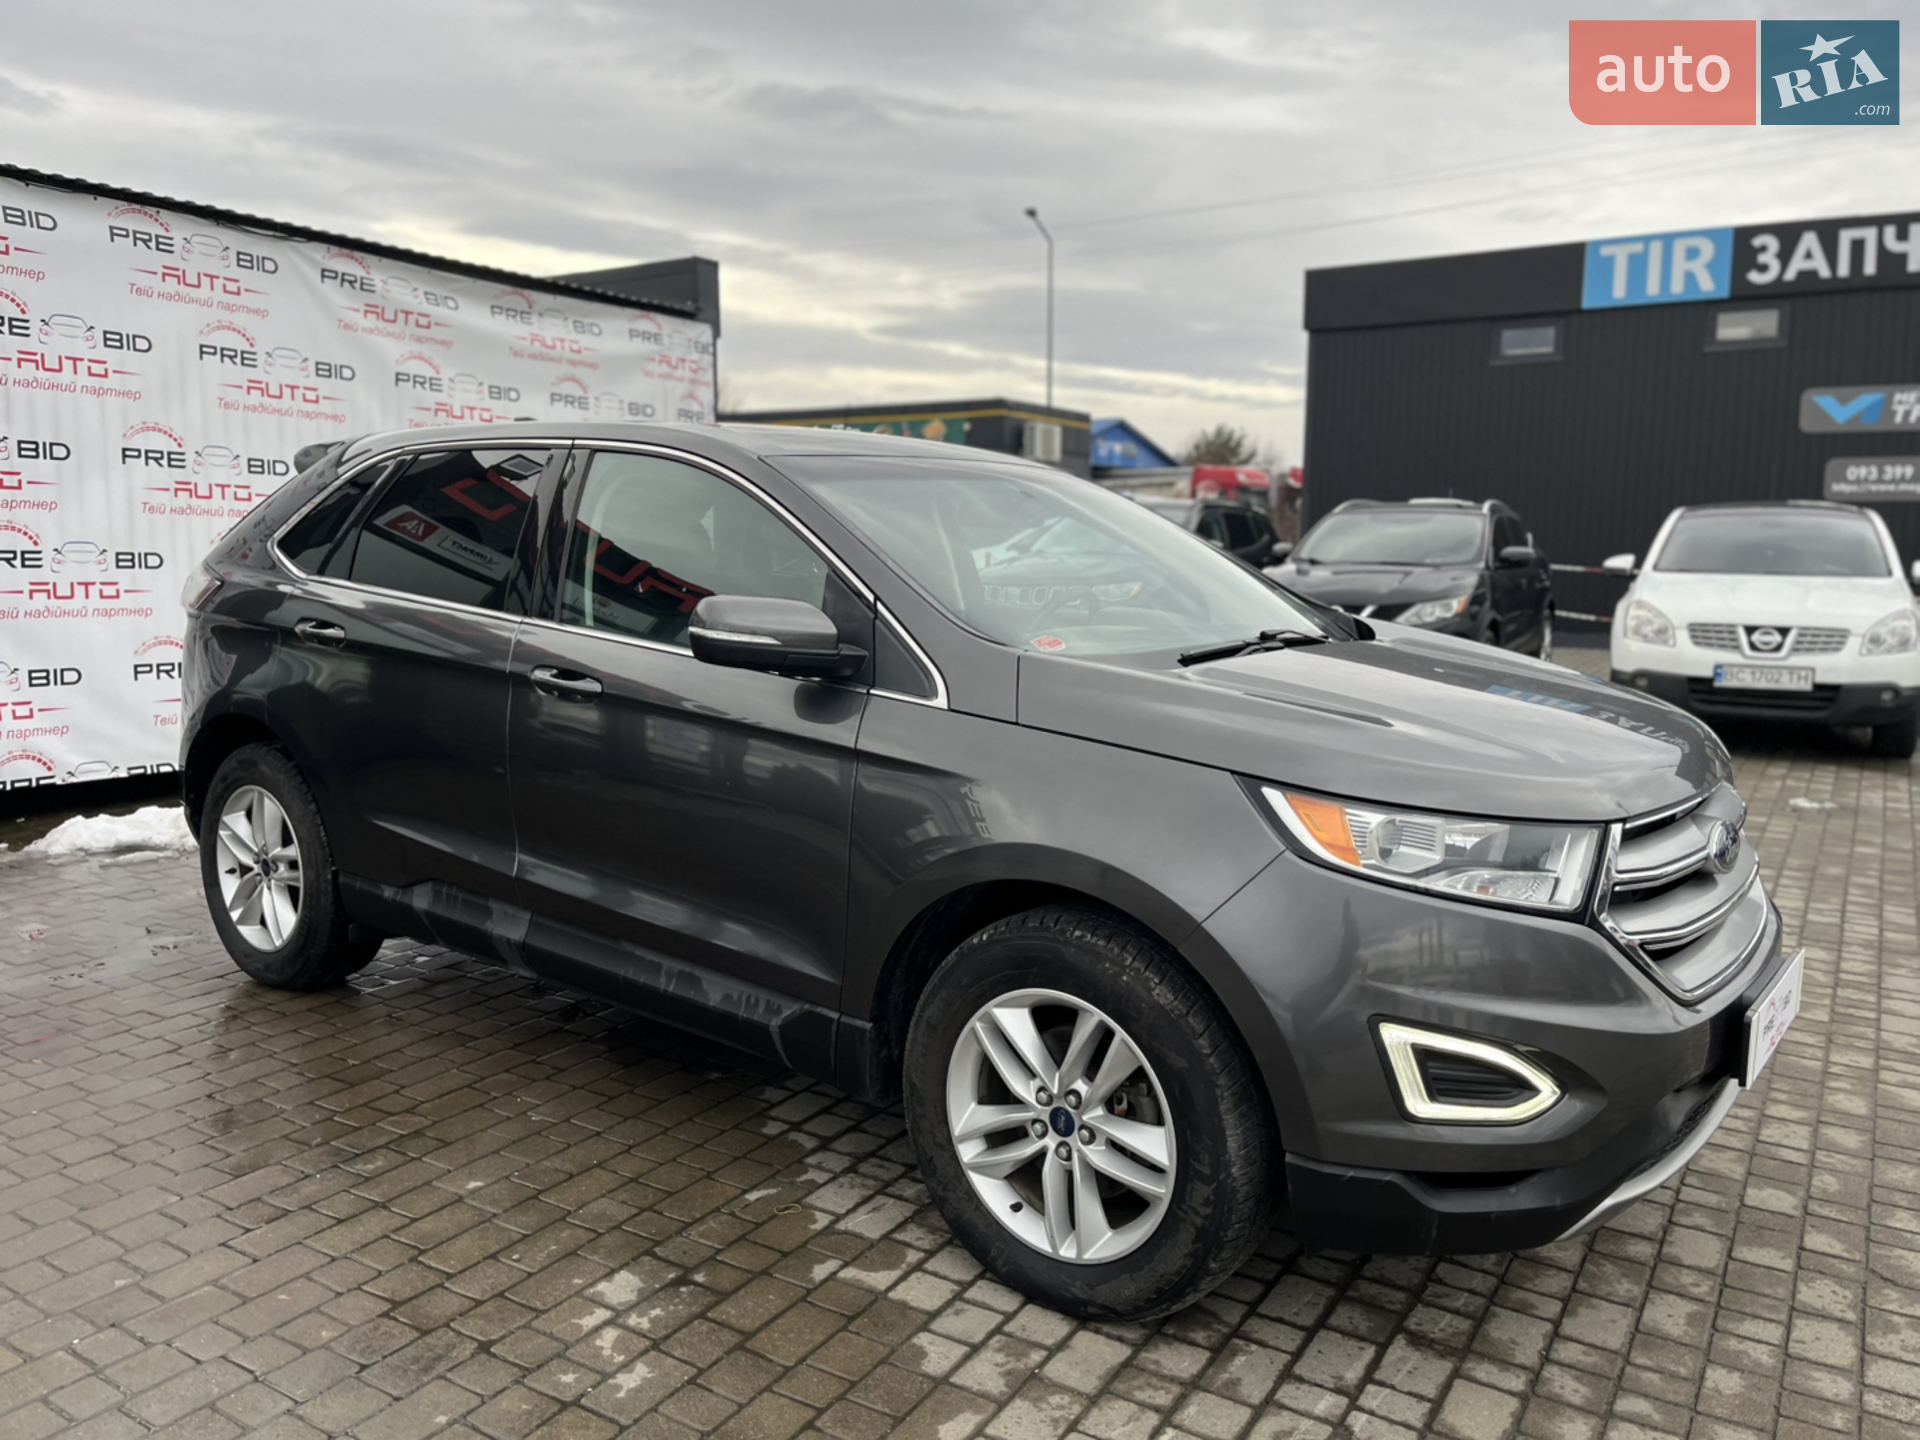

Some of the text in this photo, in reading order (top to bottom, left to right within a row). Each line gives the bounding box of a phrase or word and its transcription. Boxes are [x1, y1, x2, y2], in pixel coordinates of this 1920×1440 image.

[2, 205, 58, 231] BID
[108, 225, 279, 275] PRE BID
[1745, 222, 1920, 285] ЗАПЧ
[1599, 235, 1716, 300] TIR
[161, 264, 242, 297] AUTO
[320, 268, 460, 311] PRE BID
[128, 282, 270, 320] Твій надійний партнер
[363, 303, 432, 330] AUTO
[490, 305, 533, 326] PRE
[103, 330, 153, 353] BID
[16, 350, 109, 379] AUTO
[199, 344, 356, 381] PRE BID
[13, 376, 77, 393] надійний
[80, 384, 142, 402] партнер
[246, 379, 320, 404] AUTO
[395, 371, 521, 402] PRE BID
[242, 402, 294, 418] надійний
[296, 409, 346, 424] партнер
[434, 401, 493, 424] AUTO
[550, 392, 590, 411] PRE
[17, 439, 71, 461] BID
[121, 447, 290, 476] PRE BID
[174, 480, 252, 502] AUTO
[140, 502, 166, 515] Твій
[170, 503, 225, 518] надійний
[115, 551, 164, 570] BID
[28, 581, 120, 600] AUTO
[23, 605, 88, 620] надійний
[92, 606, 153, 620] партнер
[28, 667, 82, 688] BID
[133, 662, 182, 682] PR
[153, 714, 178, 727] Твій
[6, 724, 70, 741] партнер
